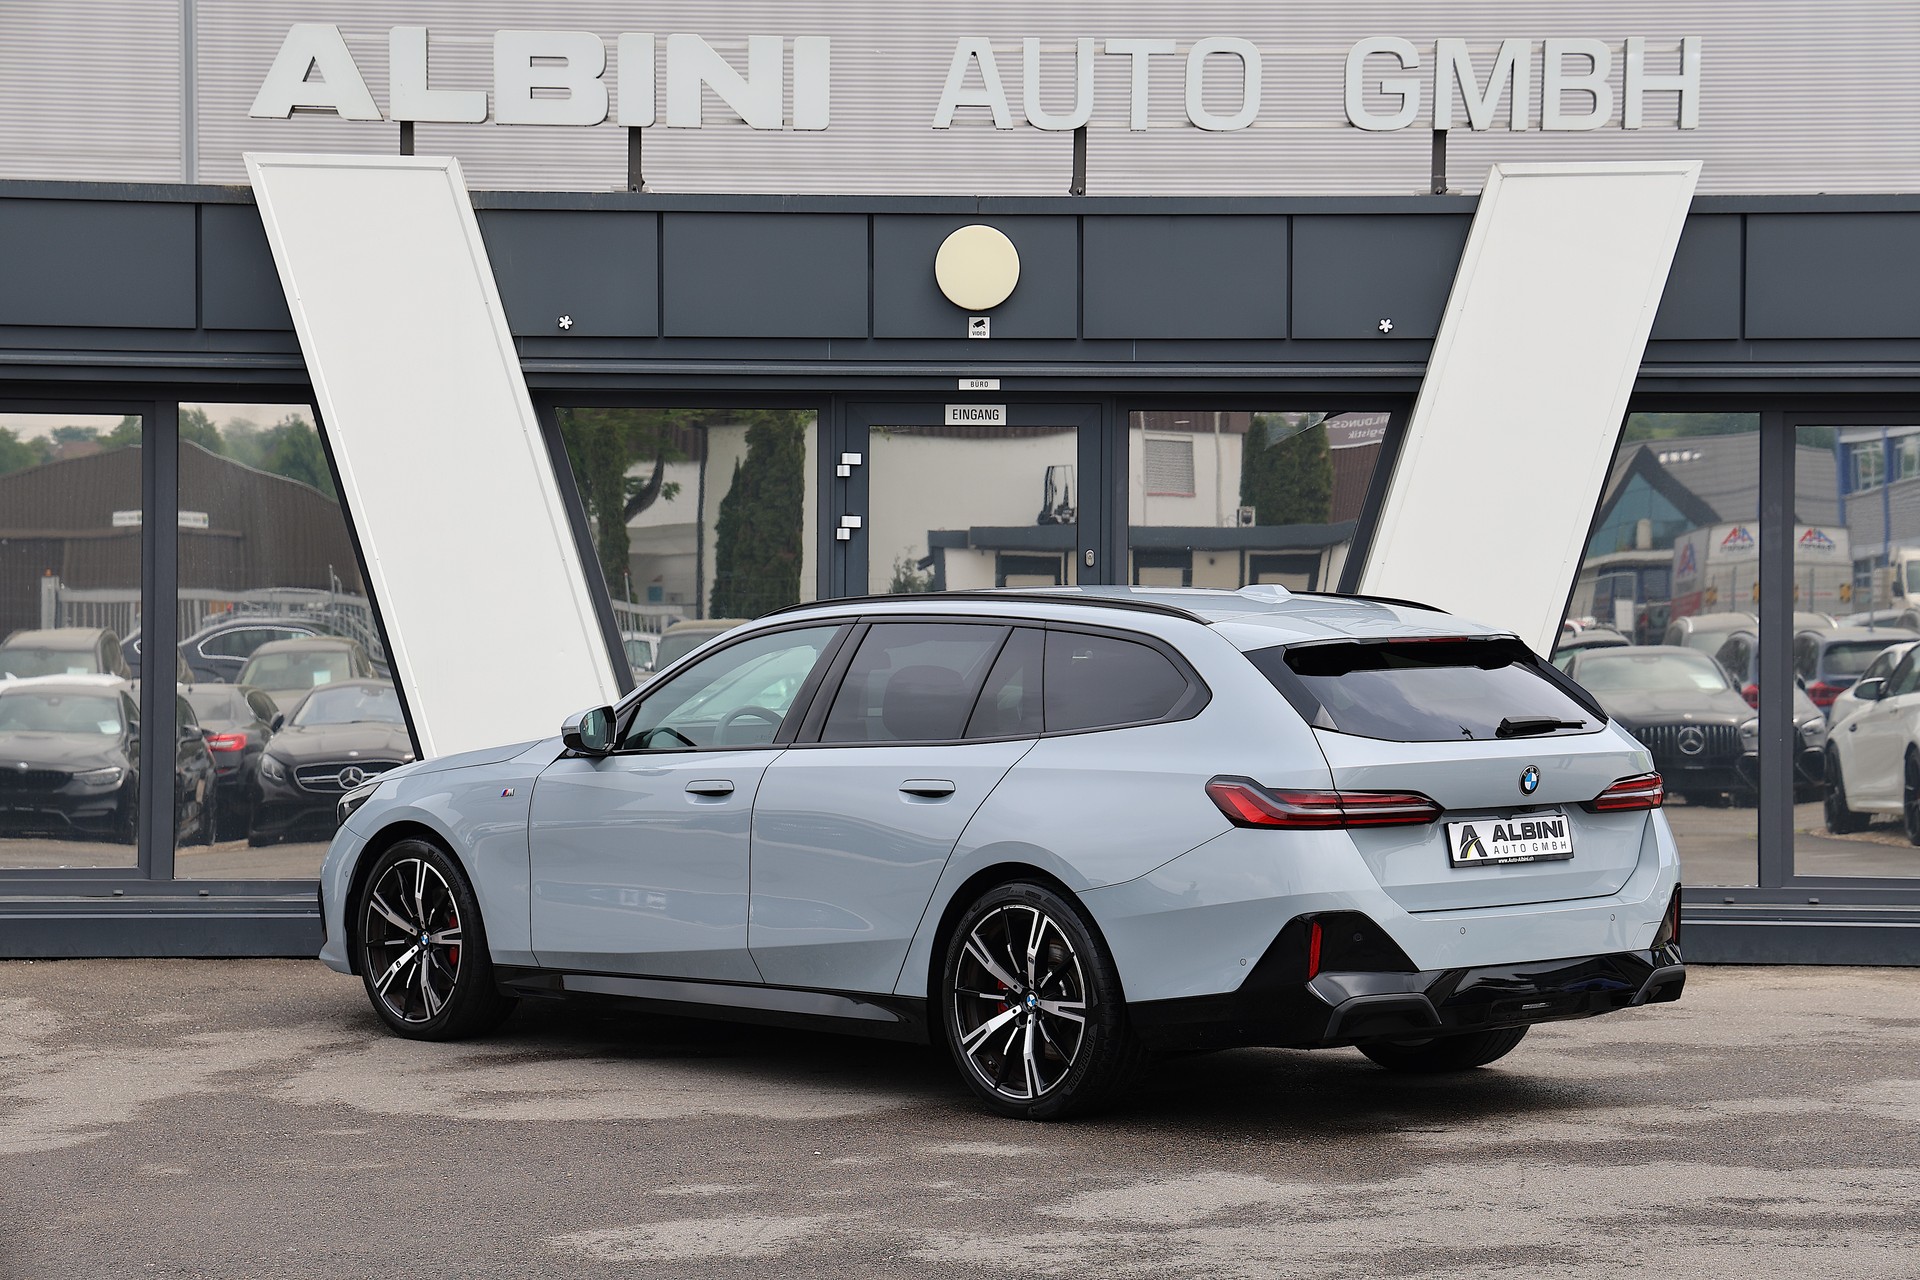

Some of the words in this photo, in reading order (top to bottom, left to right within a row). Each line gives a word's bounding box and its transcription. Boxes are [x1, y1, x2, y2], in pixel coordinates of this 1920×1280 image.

[248, 23, 831, 131] ALBINI
[932, 36, 1263, 132] AUTO
[1344, 36, 1702, 132] GMBH
[970, 380, 989, 388] BÜRO
[952, 408, 999, 421] EINGANG
[1492, 820, 1565, 842] ALBINI
[1493, 843, 1527, 855] AUTO
[1532, 841, 1567, 853] GMBH
